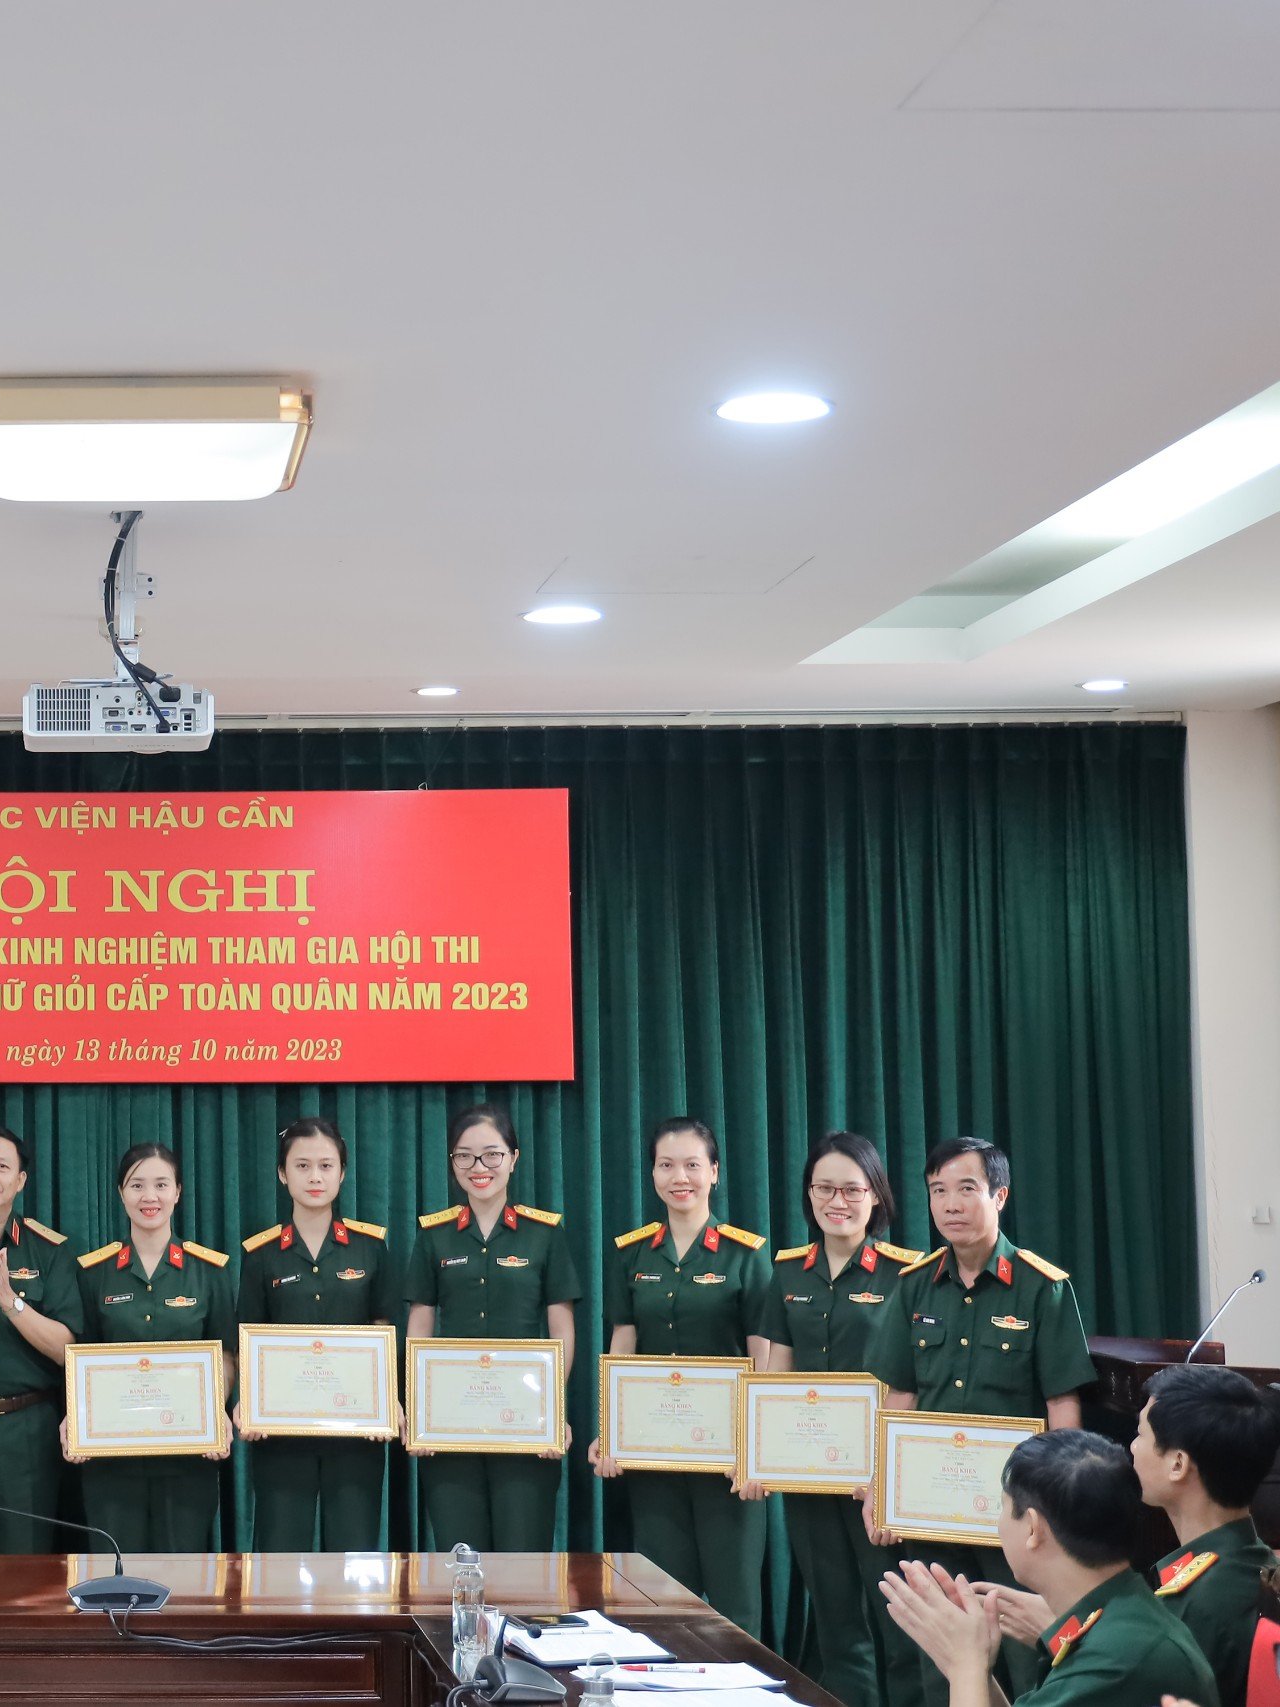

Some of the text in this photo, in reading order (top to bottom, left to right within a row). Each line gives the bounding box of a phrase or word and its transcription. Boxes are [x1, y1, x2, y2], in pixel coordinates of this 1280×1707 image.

[34, 800, 116, 835] VIỆN
[129, 800, 205, 836] HẬU
[217, 796, 294, 829] CẦN
[104, 868, 316, 926] NGHỊ
[74, 930, 197, 971] NGHIỆM
[207, 936, 296, 965] THAM
[306, 936, 360, 965] GIA
[369, 929, 421, 971] HỘI
[430, 935, 480, 964] THI
[33, 974, 95, 1012] GIỎI
[106, 973, 169, 1012] CẤP
[178, 977, 261, 1011] TOÀN
[271, 976, 358, 1014] QUÂN
[368, 976, 442, 1011] NĂM
[451, 982, 528, 1011] 2023
[6, 1038, 66, 1067] ngày
[72, 1038, 101, 1062] 13
[108, 1037, 183, 1067] tháng
[189, 1038, 217, 1061] 10
[224, 1038, 279, 1061] năm
[285, 1038, 343, 1062] 2023
